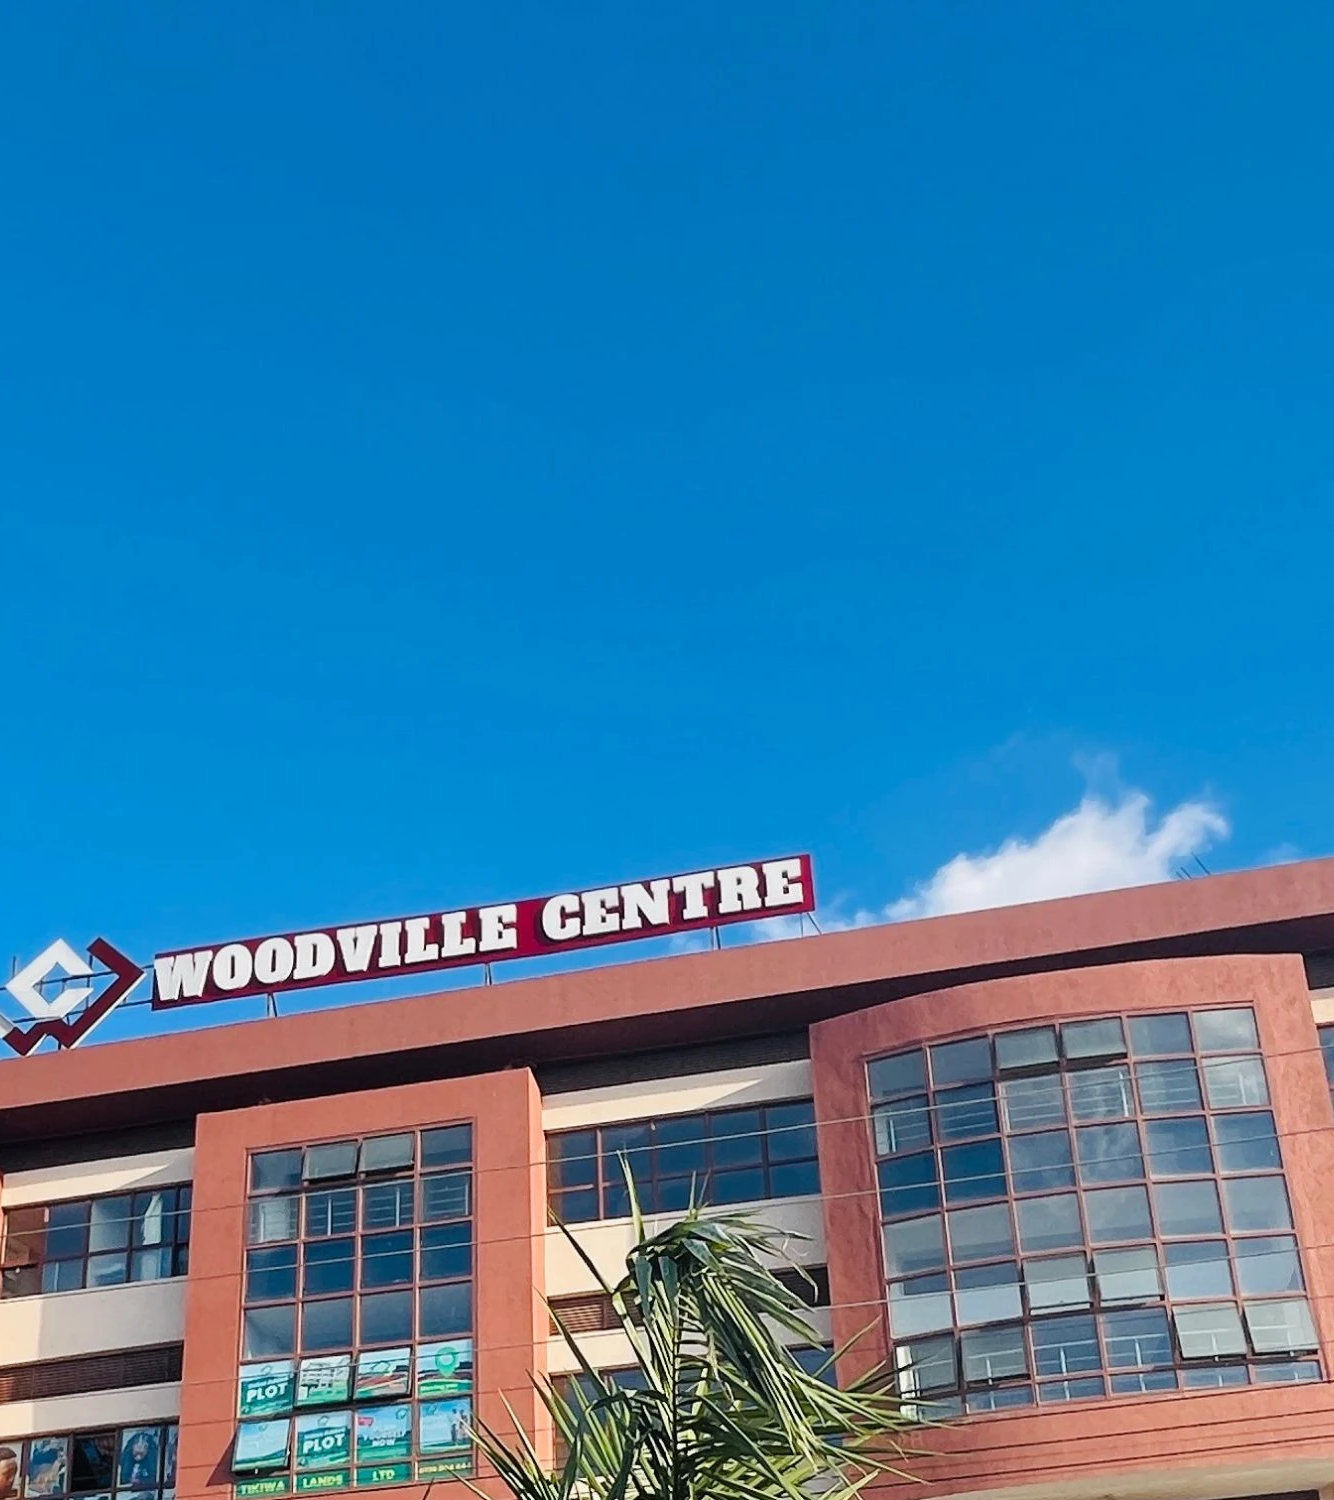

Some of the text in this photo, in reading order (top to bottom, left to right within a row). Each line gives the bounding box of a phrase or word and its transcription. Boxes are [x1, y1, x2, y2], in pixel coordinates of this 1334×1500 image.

[153, 858, 805, 1002] WOODVILLE CENTRE
[246, 1381, 288, 1403] PLOT
[303, 1433, 345, 1454] PLOT
[240, 1480, 285, 1495] TIKIWA
[302, 1474, 344, 1488] LANDS
[372, 1469, 396, 1481] LTD
